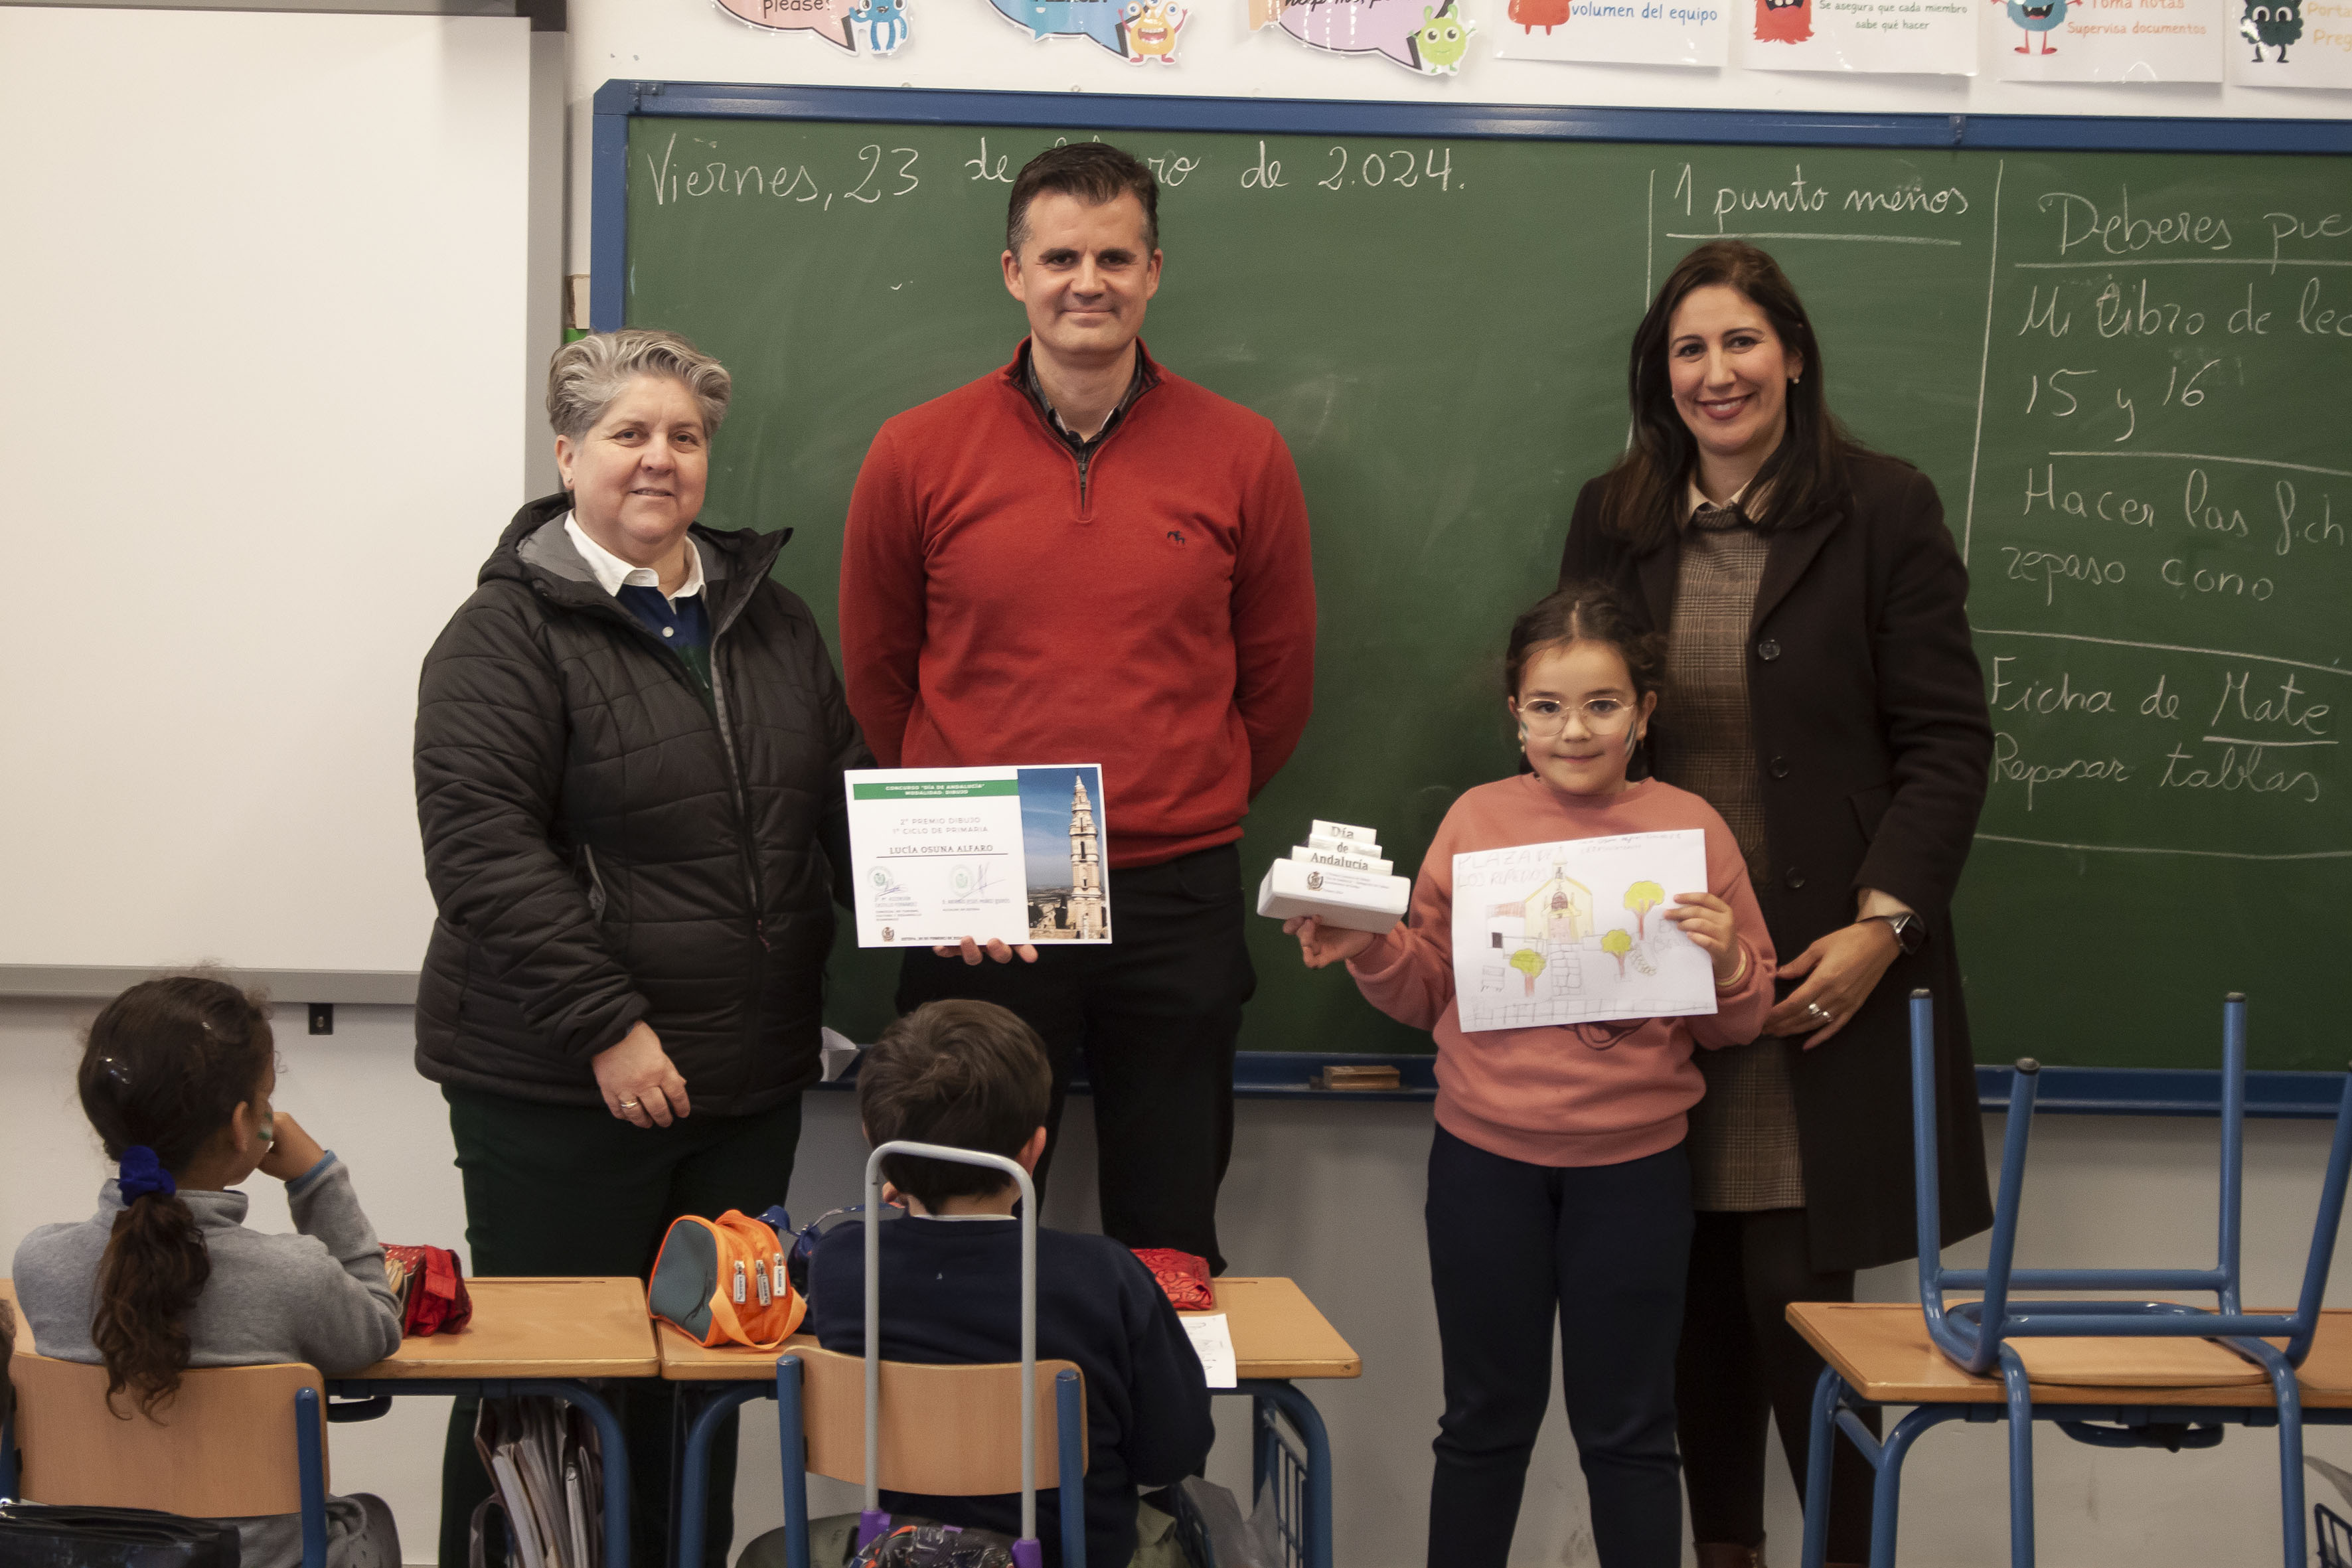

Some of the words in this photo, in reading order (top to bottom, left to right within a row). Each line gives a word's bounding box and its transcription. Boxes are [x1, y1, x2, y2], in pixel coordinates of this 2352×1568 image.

[1572, 1, 1634, 17] volumen
[1642, 2, 1663, 19] del
[1670, 7, 1718, 26] equipo
[1819, 1, 1832, 10] Se
[1834, 3, 1873, 15] asegura
[1877, 3, 1895, 15] que
[1899, 1, 1921, 13] cada
[1925, 3, 1968, 14] miembro
[1855, 19, 1877, 29] sabe
[1882, 20, 1899, 33] qué
[1903, 19, 1930, 29] hacer
[2140, 0, 2185, 9] notas
[2067, 21, 2127, 39] Supervisa
[2132, 21, 2207, 34] documentos
[844, 144, 919, 203] 23
[965, 137, 1014, 183] de
[1241, 141, 1289, 189] de
[1674, 163, 1691, 216] 1
[1714, 164, 1830, 233] punto
[2037, 184, 2232, 255] Deberes
[2228, 282, 2272, 334] de
[2026, 368, 2098, 416] 15
[2114, 388, 2135, 441] y
[2163, 358, 2221, 407] 16
[2023, 463, 2154, 527] Hacer
[2185, 469, 2248, 537] las
[2001, 546, 2126, 606] repaso
[1991, 657, 2116, 714] Ficha
[2140, 674, 2180, 720] de
[2211, 671, 2330, 735] Mate
[2160, 742, 2319, 802] tablas
[890, 845, 918, 854] LUCÍA
[1331, 826, 1354, 839] Día
[1337, 842, 1349, 854] de
[1310, 852, 1368, 871] Andalucía
